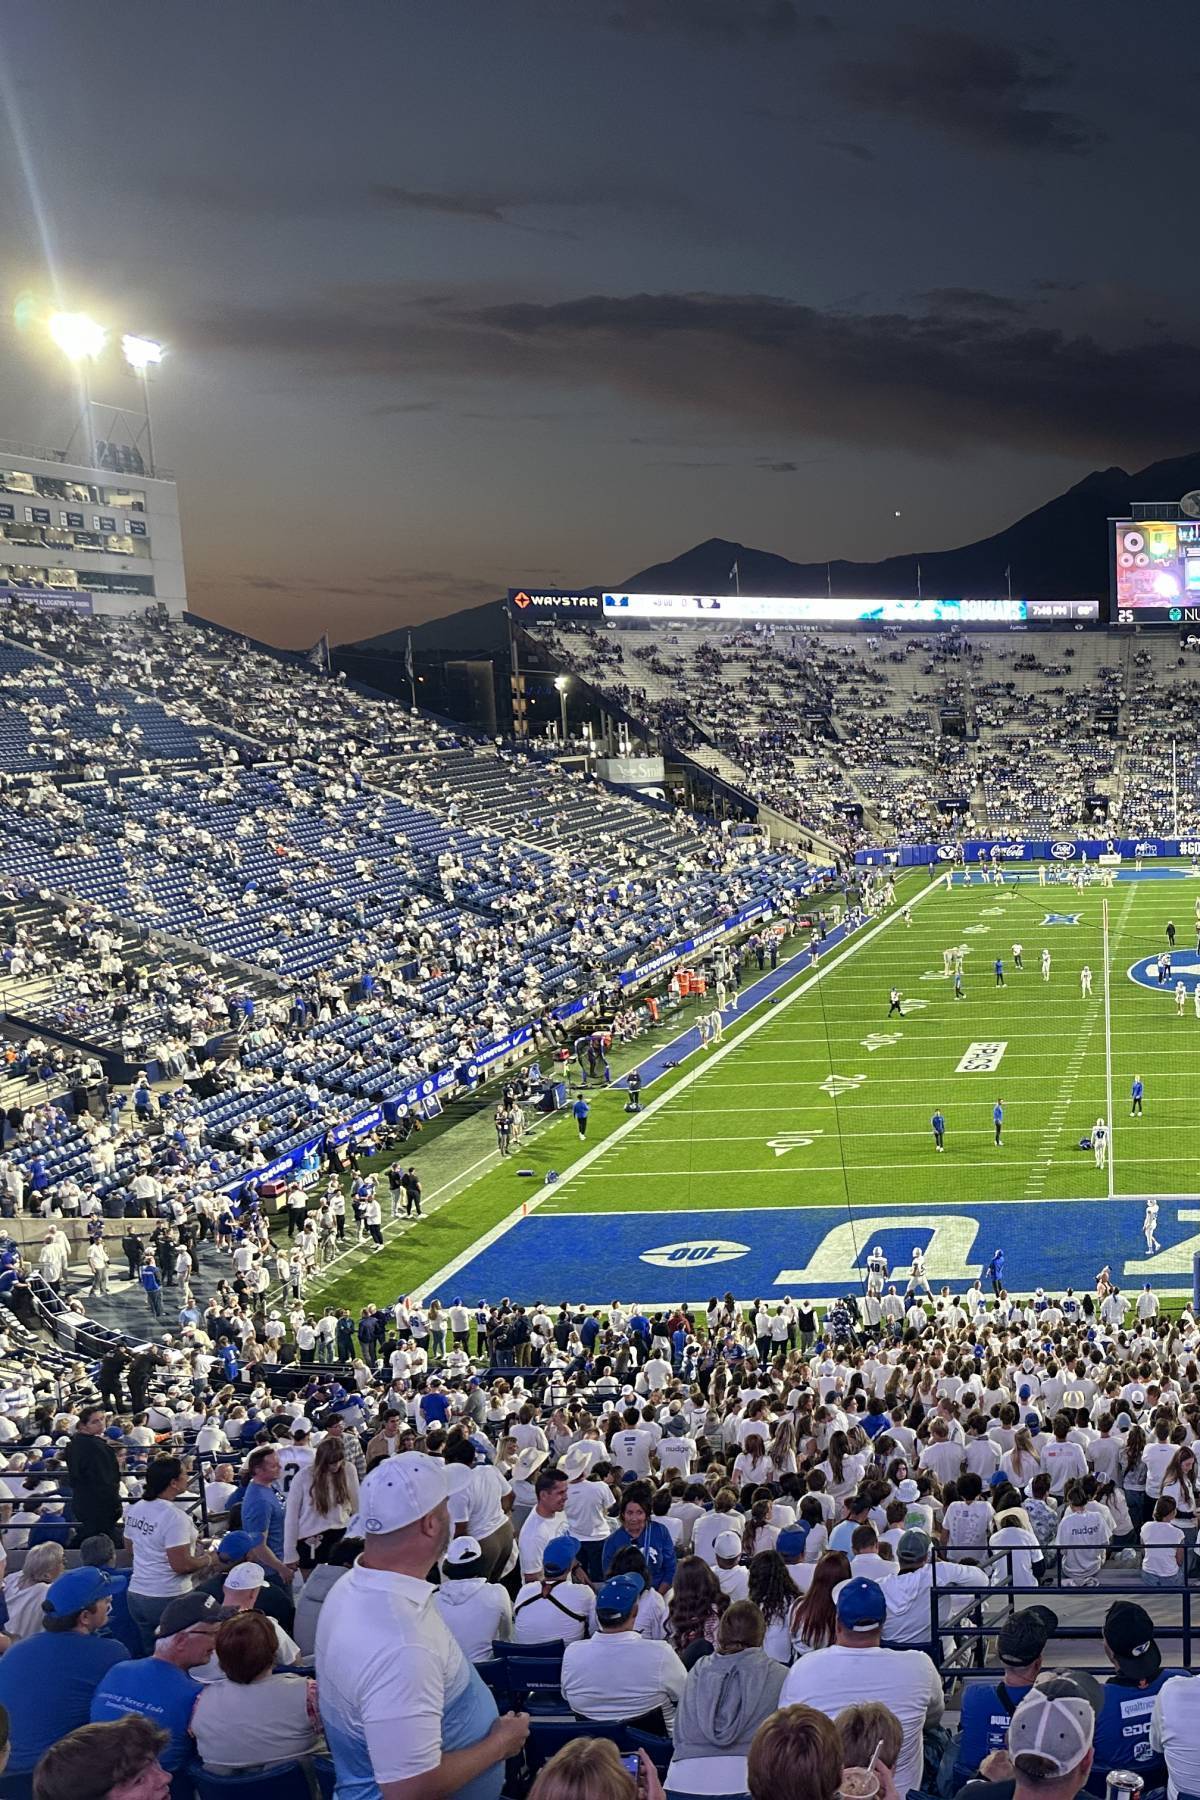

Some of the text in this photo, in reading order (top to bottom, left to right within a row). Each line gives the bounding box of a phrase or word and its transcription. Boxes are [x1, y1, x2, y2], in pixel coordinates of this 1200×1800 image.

[530, 595, 598, 607] WAYSTAR
[1118, 609, 1134, 622] 25
[648, 950, 677, 972] FOOTBALL
[667, 1246, 720, 1261] 100
[1063, 1301, 1076, 1313] 96
[125, 1516, 155, 1535] nudge
[1071, 1525, 1098, 1536] nudge
[990, 1715, 1011, 1726] BUILT
